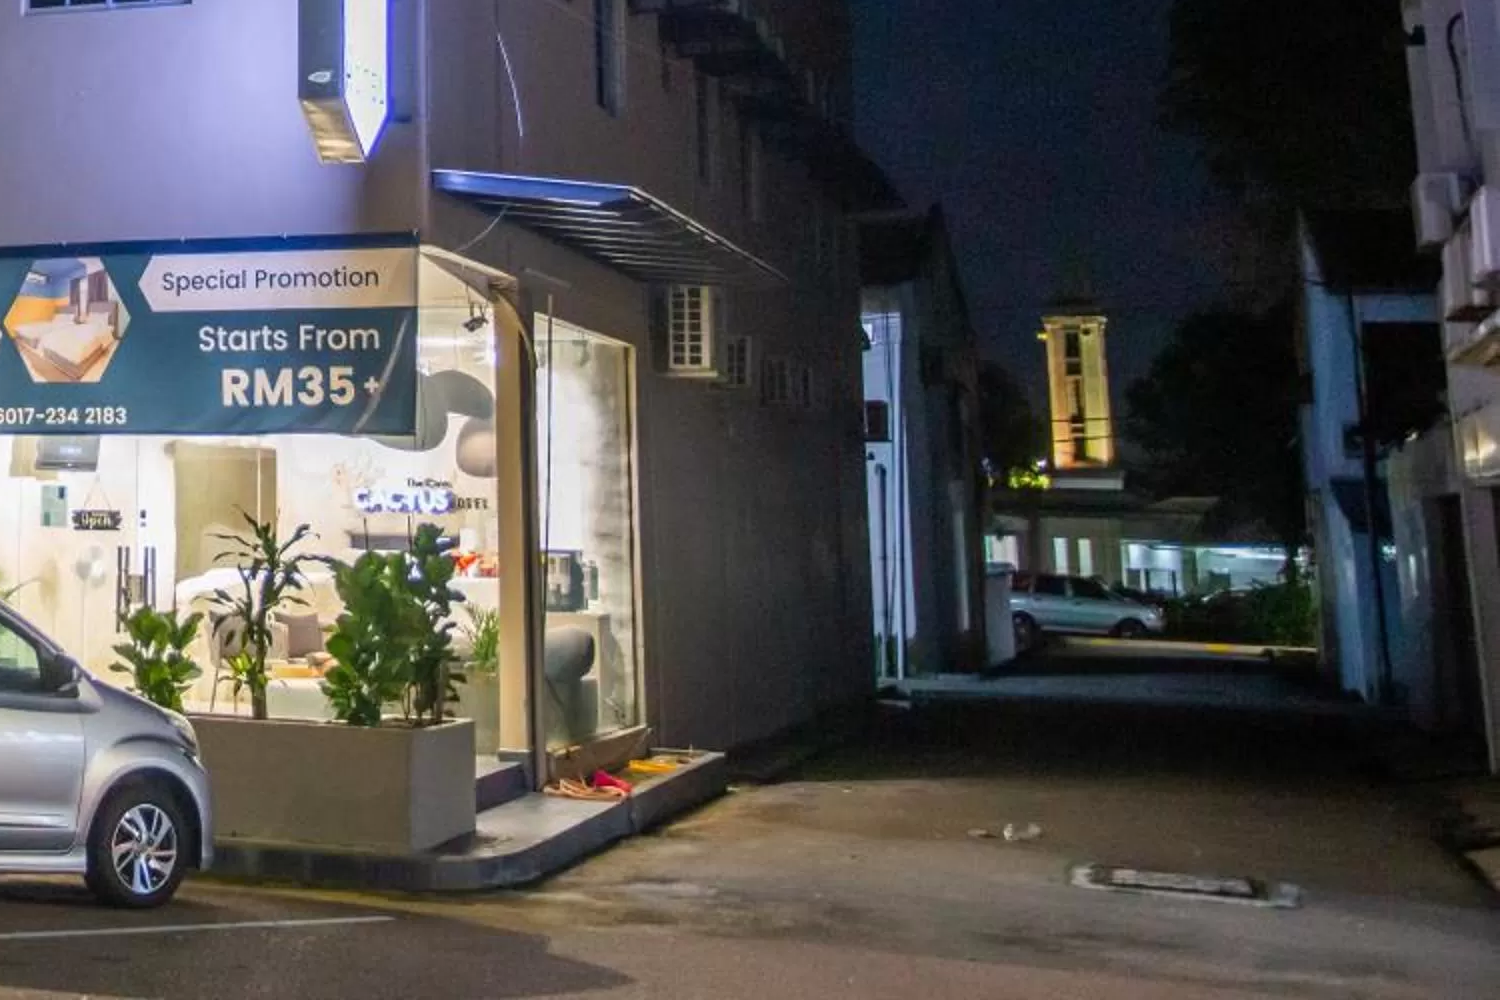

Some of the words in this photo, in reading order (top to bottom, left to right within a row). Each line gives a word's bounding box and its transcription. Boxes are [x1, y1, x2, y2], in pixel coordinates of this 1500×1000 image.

[162, 269, 247, 296] Special
[254, 266, 380, 290] Promotion
[199, 325, 288, 352] Starts
[299, 325, 380, 351] From
[84, 407, 128, 425] 2183
[357, 488, 455, 514] CACTUS
